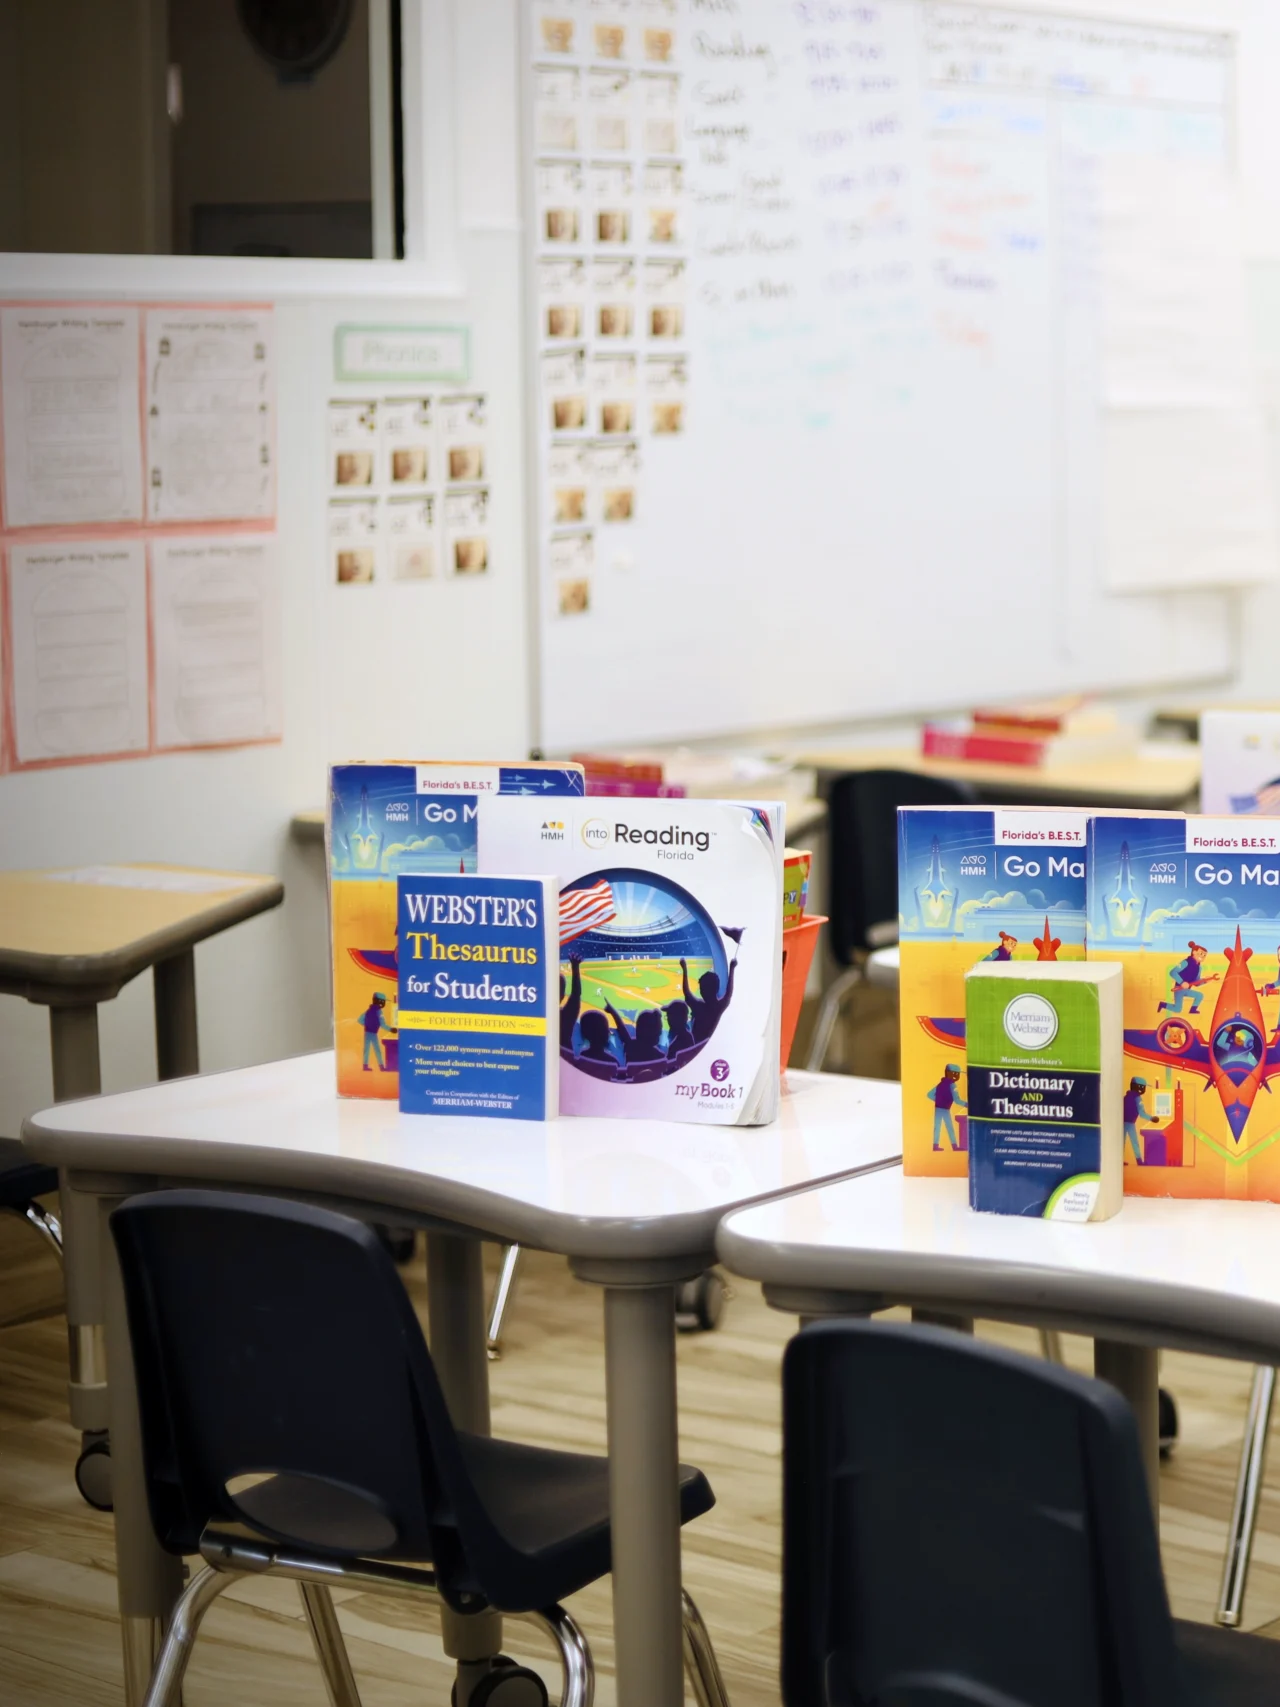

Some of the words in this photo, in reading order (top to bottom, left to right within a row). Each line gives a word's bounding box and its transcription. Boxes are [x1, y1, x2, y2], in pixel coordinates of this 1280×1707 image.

[423, 780, 461, 790] Florida's
[463, 781, 493, 790] B.E.S.T.
[386, 813, 409, 822] HMH
[424, 803, 457, 823] Go
[541, 832, 564, 841] HMH
[585, 827, 608, 840] into
[614, 823, 710, 852] Reading
[1002, 830, 1045, 840] Florida's
[1048, 831, 1082, 841] B.E.S.T.
[1193, 837, 1238, 848] Florida's
[1241, 838, 1276, 848] B.E.S.T.
[657, 849, 694, 861] Florida
[960, 866, 986, 876] HMH
[1003, 856, 1041, 878] Go
[1150, 875, 1176, 884] HMH
[1194, 863, 1232, 886] Go
[405, 893, 537, 929] WEBSTER'S
[406, 931, 537, 965] Thesaurus
[407, 974, 430, 993] for
[434, 971, 537, 1003] Students
[428, 1016, 472, 1027] FOURTH
[474, 1018, 517, 1029] EDITION
[1012, 1023, 1050, 1035] Webster
[415, 1043, 432, 1052] Over
[460, 1046, 491, 1056] synonyms
[492, 1047, 504, 1055] and
[504, 1048, 534, 1058] antonyms
[415, 1058, 433, 1066] More
[434, 1059, 450, 1067] word
[451, 1060, 475, 1068] choices
[484, 1061, 497, 1069] best
[497, 1063, 520, 1072] express
[1001, 1056, 1063, 1066] Merriam-Webster's
[414, 1068, 429, 1076] your
[430, 1068, 460, 1078] thoughts
[716, 1067, 724, 1080] 3
[989, 1071, 1075, 1096] Dictionary
[433, 1097, 512, 1110] MERRIAM-WEBSTER
[1021, 1092, 1044, 1102] AND
[697, 1101, 724, 1110] Modules
[991, 1098, 1074, 1119] Thesaurus
